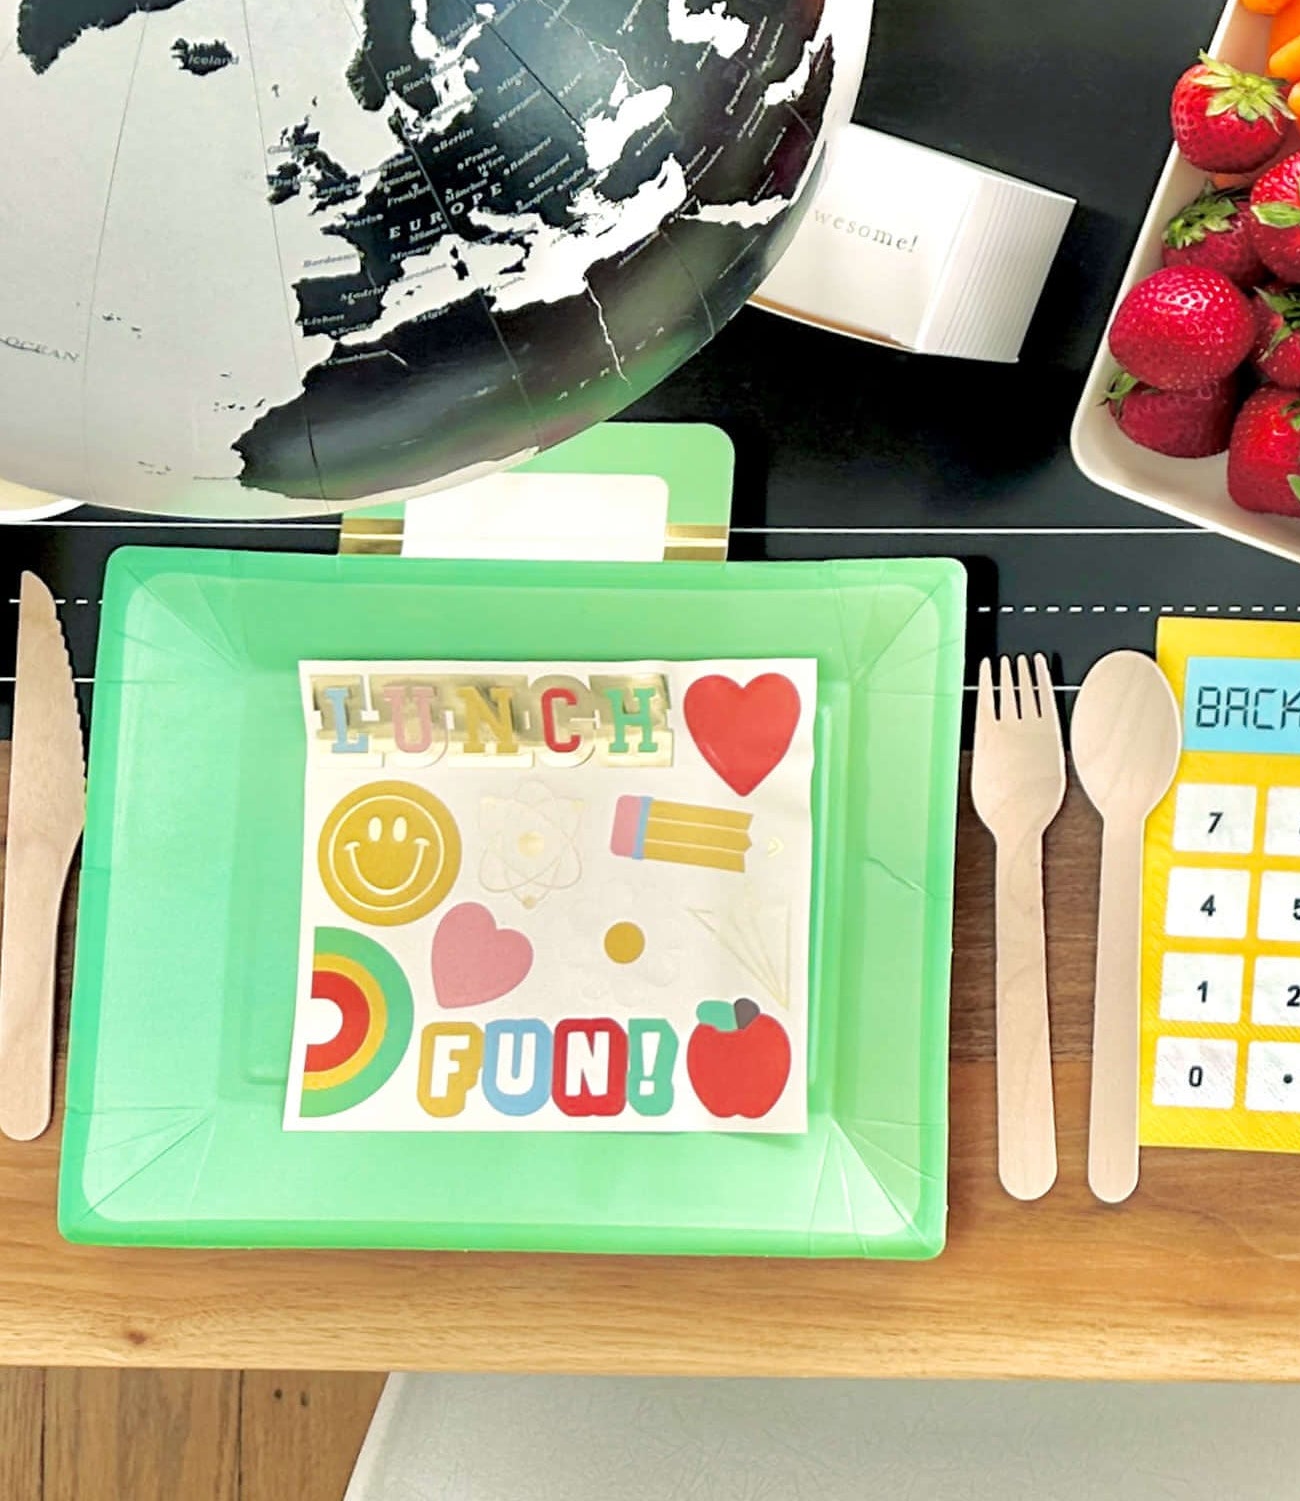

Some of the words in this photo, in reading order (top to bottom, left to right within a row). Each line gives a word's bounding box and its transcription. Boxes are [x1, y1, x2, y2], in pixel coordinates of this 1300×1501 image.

[187, 53, 239, 67] Iceland
[388, 182, 502, 240] EUROPE
[810, 206, 920, 254] wesome!
[4, 335, 79, 363] OCEAN
[318, 680, 665, 761] LUNCH
[1208, 812, 1223, 834] 7
[1200, 895, 1216, 917] 4
[1197, 981, 1208, 1003] 1
[1286, 985, 1300, 1007] 2
[424, 1024, 671, 1108] FUN!
[1188, 1066, 1203, 1088] 0
